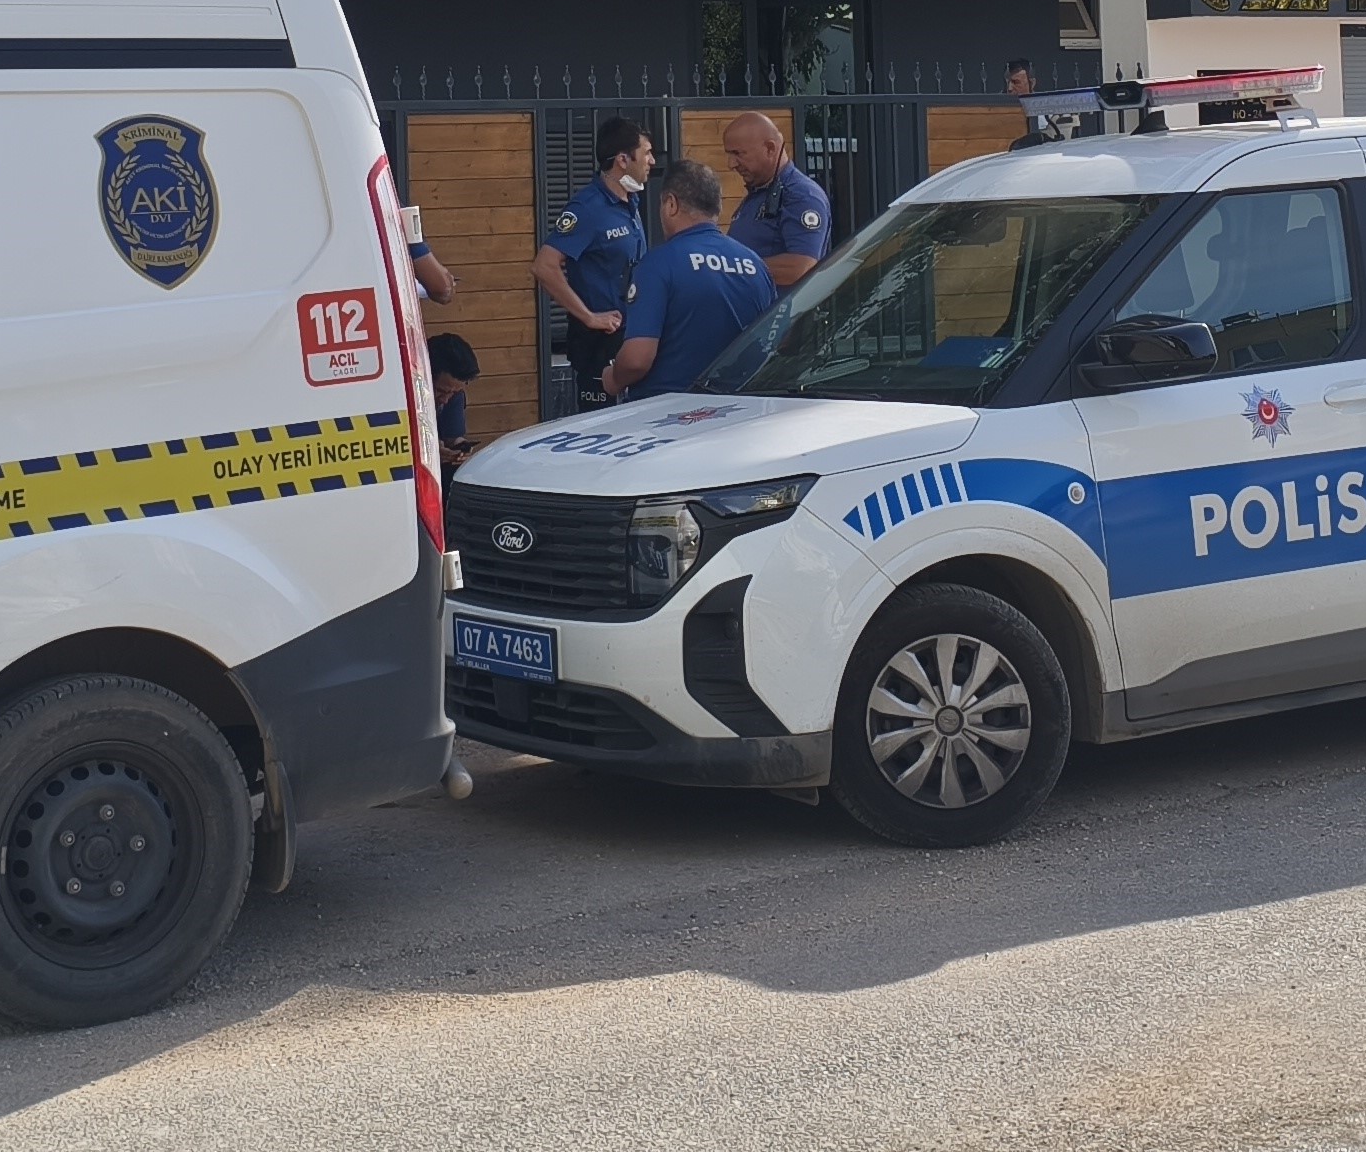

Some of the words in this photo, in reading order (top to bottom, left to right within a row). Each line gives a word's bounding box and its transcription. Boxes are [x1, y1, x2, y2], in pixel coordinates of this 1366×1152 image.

[131, 181, 188, 213] AKİ
[150, 214, 171, 224] DVI
[309, 299, 369, 346] 112
[213, 454, 264, 480] OLAY
[498, 525, 525, 549] Ford
[463, 626, 482, 652] 07
[486, 631, 500, 656] A
[502, 633, 543, 664] 7463
